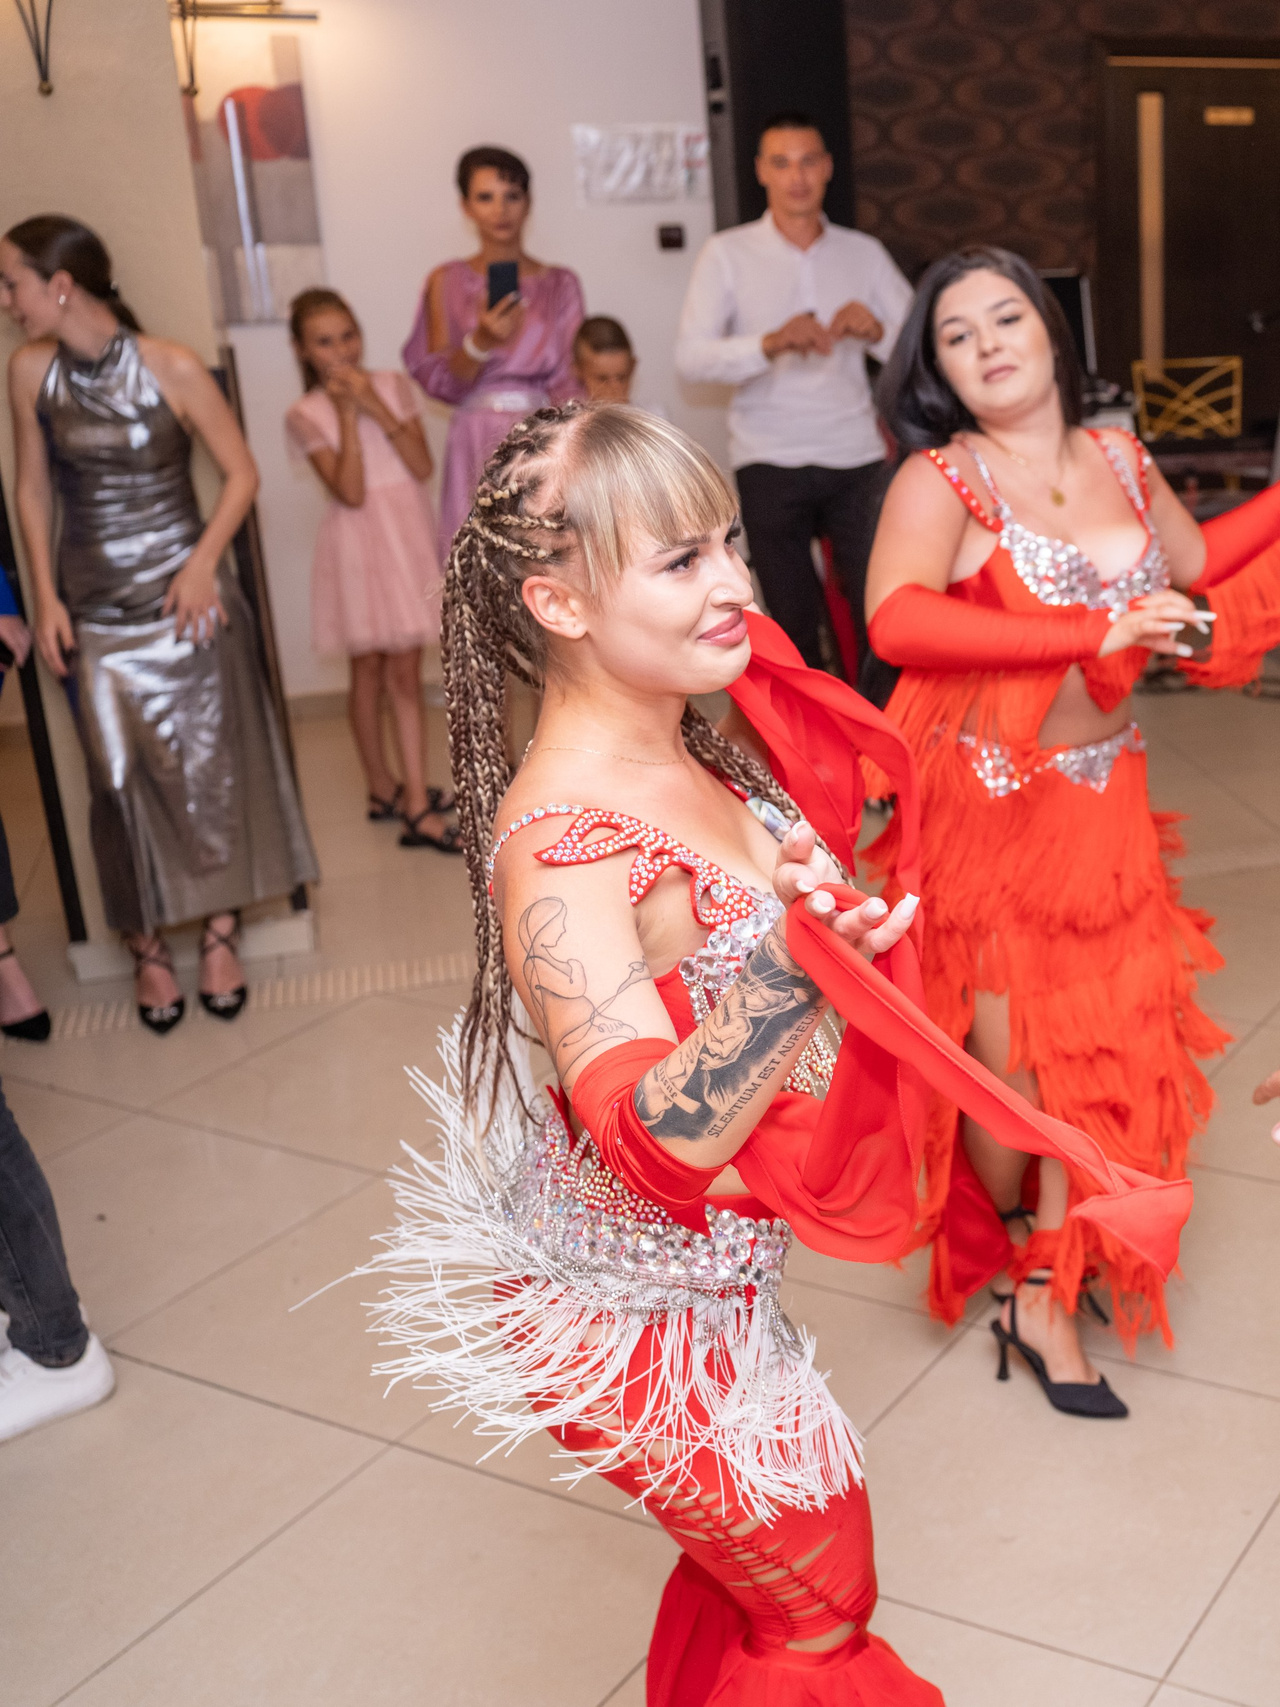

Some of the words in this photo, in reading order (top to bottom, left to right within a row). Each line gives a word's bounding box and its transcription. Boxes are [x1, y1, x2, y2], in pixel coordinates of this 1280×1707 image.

[707, 1078, 762, 1138] SILENTIUM
[757, 1058, 781, 1080] EST
[780, 1004, 824, 1057] AUREUM
